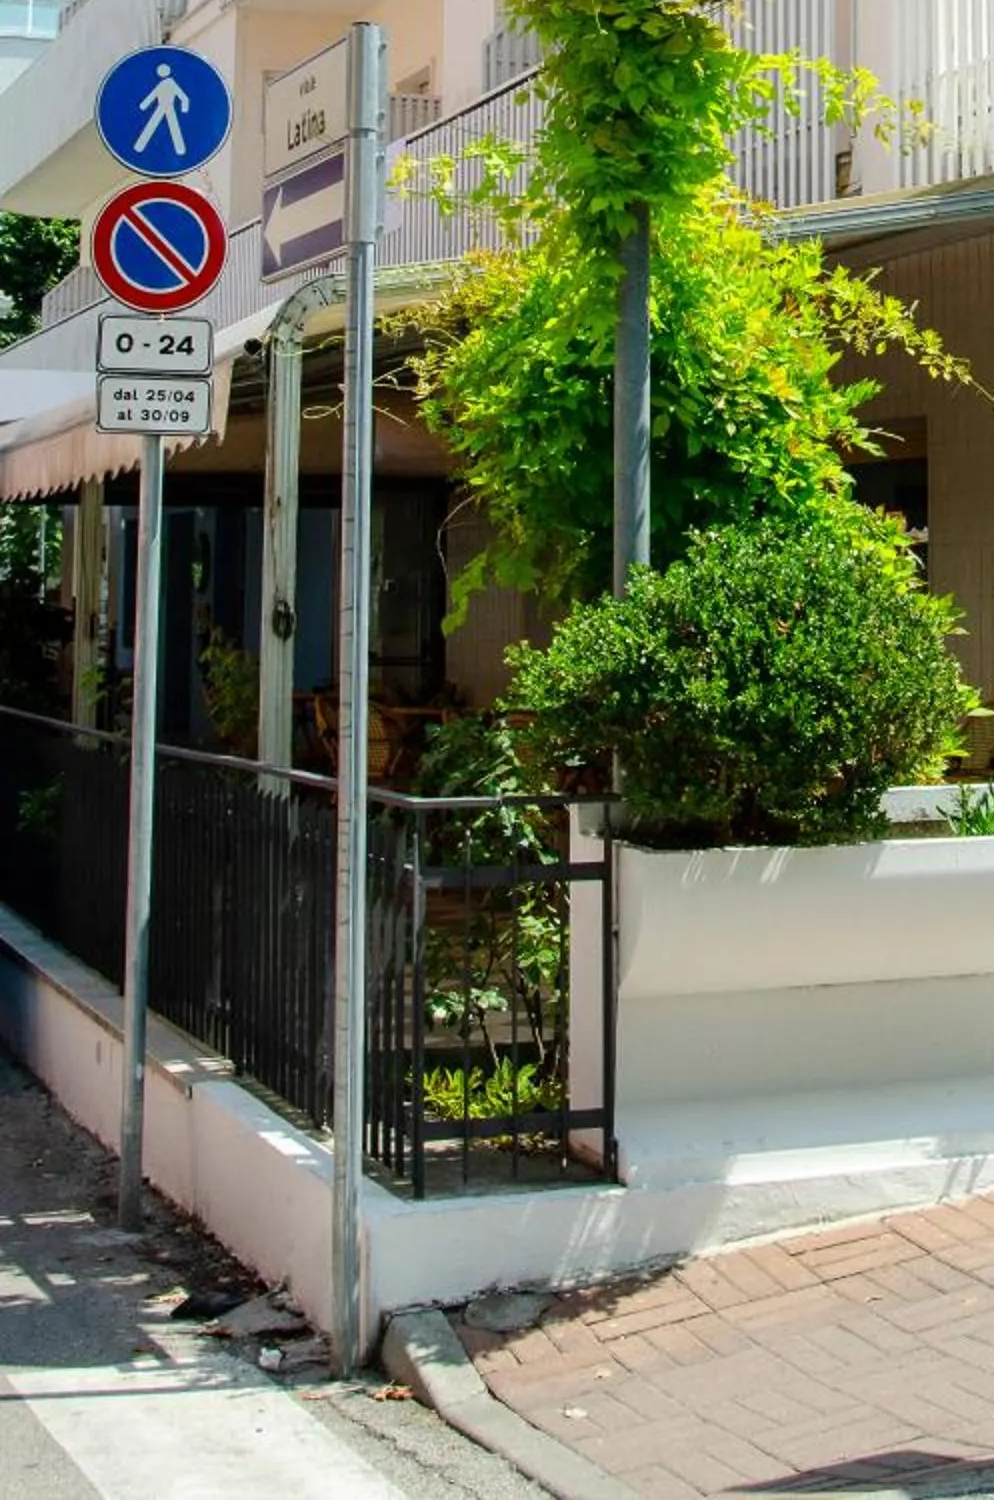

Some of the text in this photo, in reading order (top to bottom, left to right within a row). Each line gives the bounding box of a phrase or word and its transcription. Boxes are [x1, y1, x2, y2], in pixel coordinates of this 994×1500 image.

[287, 107, 326, 151] Latina
[159, 334, 195, 355] 24
[113, 388, 195, 403] dal 25/04
[117, 408, 190, 423] al 30/09
